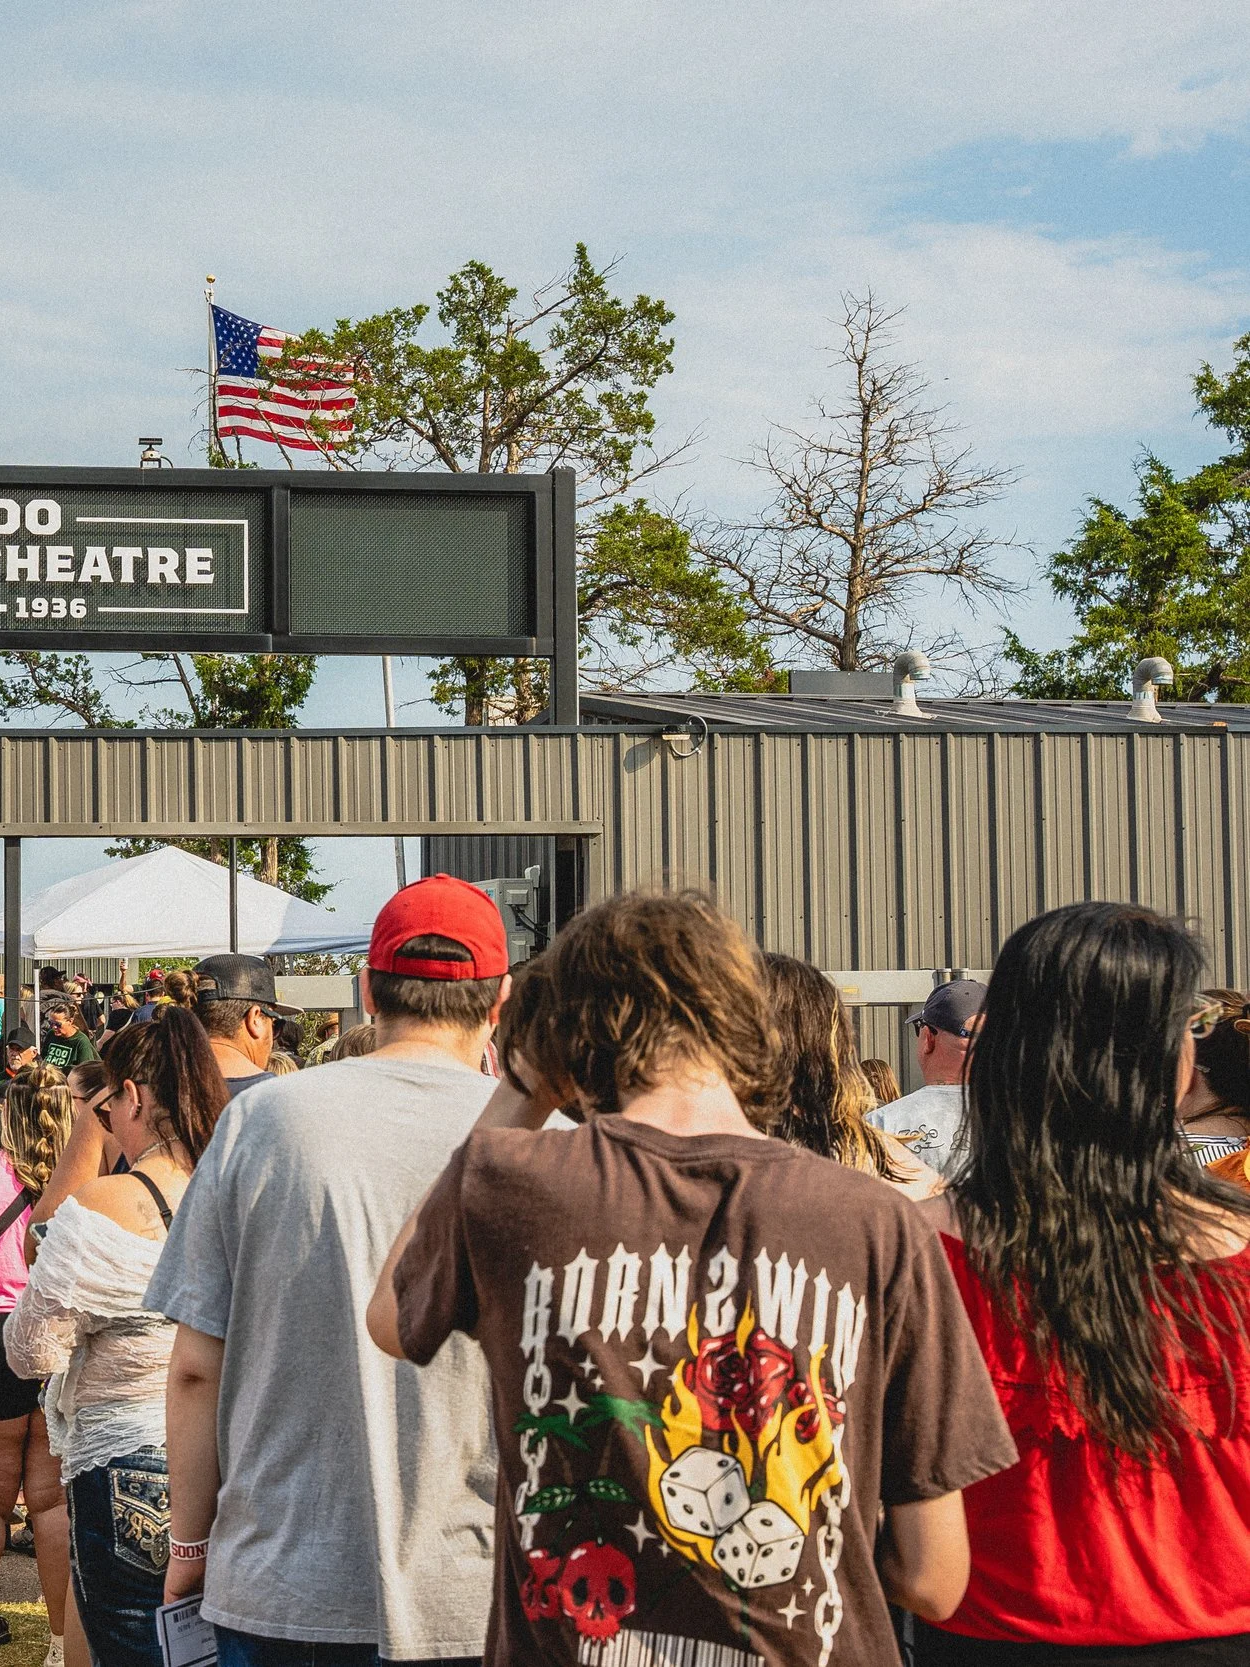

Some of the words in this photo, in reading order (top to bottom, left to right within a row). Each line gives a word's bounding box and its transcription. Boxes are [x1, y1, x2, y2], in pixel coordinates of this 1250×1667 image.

[15, 596, 87, 619] 1936
[46, 1056, 66, 1066] AMP
[49, 1046, 69, 1059] ZOO
[520, 1242, 693, 1359] BORN
[704, 1245, 740, 1337] 2
[753, 1246, 868, 1394] WIN
